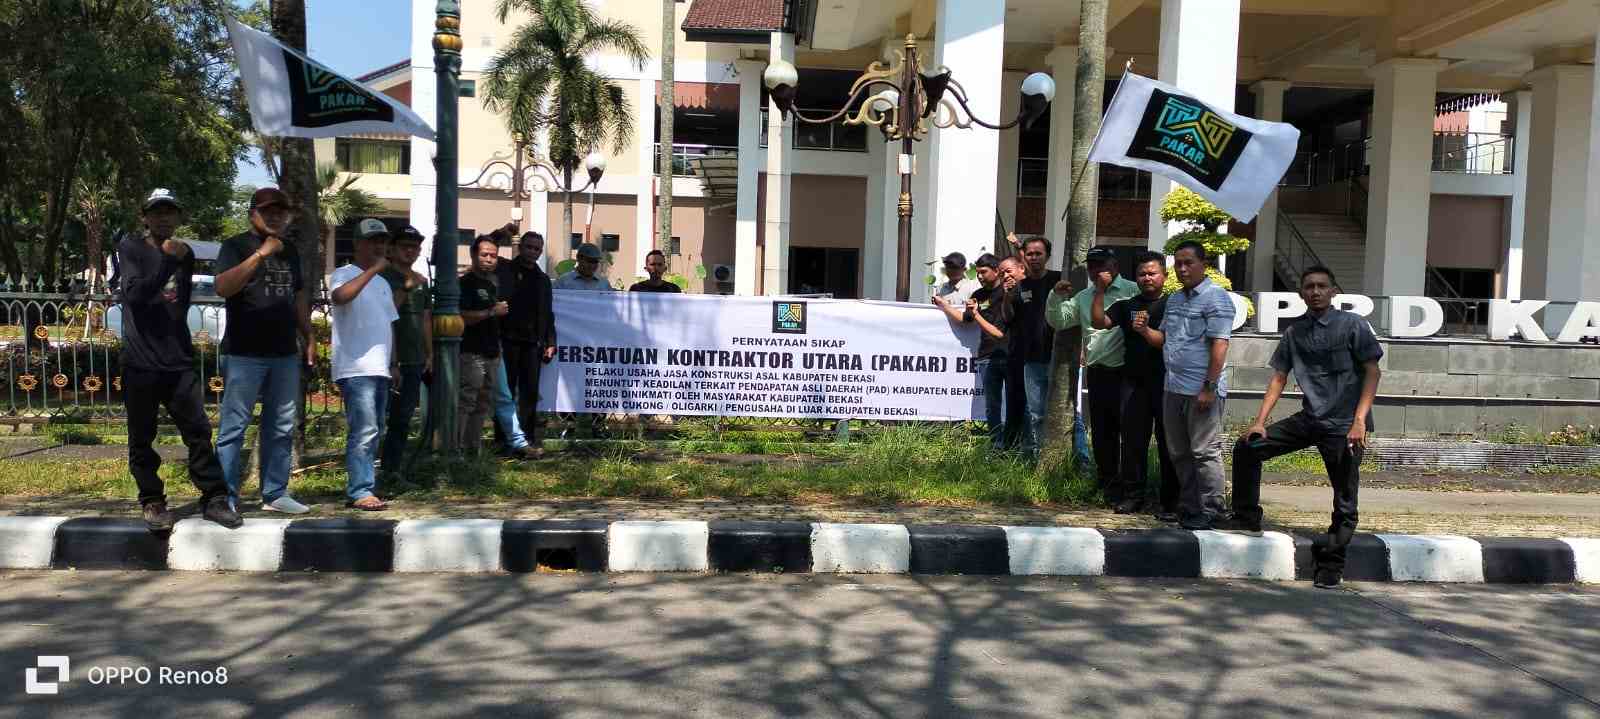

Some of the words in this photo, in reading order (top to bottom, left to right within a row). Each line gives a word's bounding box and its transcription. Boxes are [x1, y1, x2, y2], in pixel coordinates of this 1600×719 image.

[319, 92, 366, 110] PAKAR
[1160, 135, 1206, 162] PAKAR
[1488, 298, 1600, 343] KA
[732, 336, 808, 348] PERNYATAAN
[811, 338, 846, 349] SIKAP
[667, 349, 794, 369] KONTRAKTOR
[802, 352, 863, 371] UTARA
[871, 354, 948, 373] (PAKAR)
[585, 367, 625, 377] PELAKU
[627, 368, 660, 378] USAHA
[663, 369, 688, 379] JASA
[691, 370, 753, 380] KONSTRUKSI
[756, 371, 780, 381] ASAL
[782, 372, 838, 383] KABUPATEN
[841, 374, 876, 383] BEKASI
[585, 378, 640, 388] MENUNTUT
[643, 379, 692, 390] KEADILAN
[695, 381, 736, 391] TERKAIT
[738, 382, 799, 393] PENDAPATAN
[801, 383, 823, 393] ASLI
[825, 384, 863, 394] DAERAH
[865, 385, 890, 396] (PAD)
[893, 386, 948, 396] KABUPATEN
[585, 389, 619, 399] HARUS
[621, 390, 672, 400] DINIKMATI
[674, 391, 701, 401] OLEH
[703, 392, 767, 402] MASYARAKAT
[769, 393, 826, 404] KABUPATEN
[828, 395, 863, 404] BEKASI
[585, 400, 619, 409] BUKAN
[622, 400, 664, 411] CUKONG
[671, 401, 717, 412] OLIGARKI
[725, 403, 785, 413] PENGUSAHA
[786, 404, 796, 413] DI
[798, 405, 823, 414] LUAR
[825, 406, 881, 416] KABUPATEN
[884, 407, 918, 416] BEKASI
